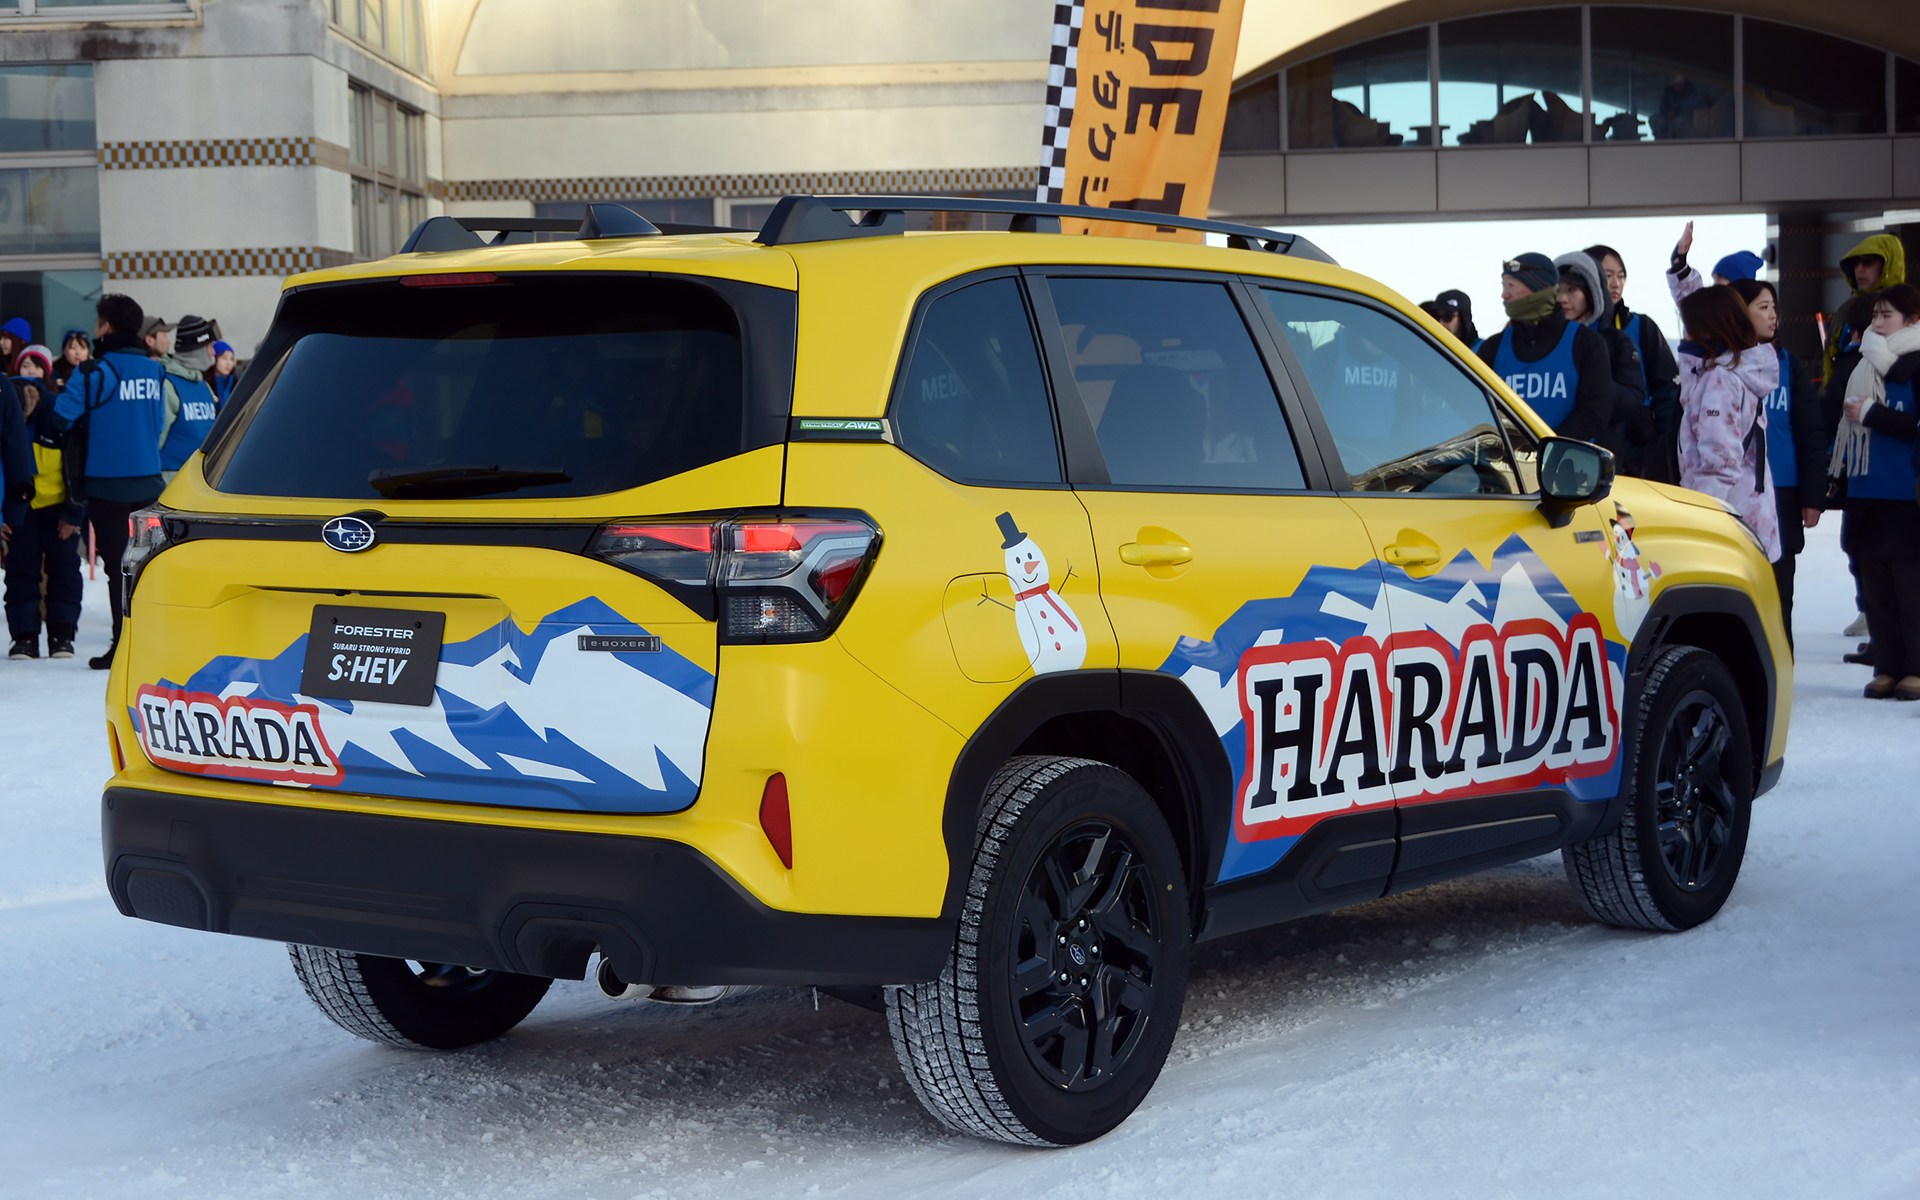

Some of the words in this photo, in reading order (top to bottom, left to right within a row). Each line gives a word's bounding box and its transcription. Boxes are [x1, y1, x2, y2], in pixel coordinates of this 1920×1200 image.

[1345, 366, 1398, 388] MEDIA
[844, 421, 880, 430] AWD
[214, 551, 510, 575] FORESTER
[334, 624, 415, 640] FORESTER
[332, 642, 358, 651] SUBARU
[358, 644, 385, 653] STRONG
[385, 646, 411, 655] HYBRID
[327, 654, 408, 685] S:HEV
[143, 703, 329, 768] HARADA
[1250, 641, 1607, 809] HARADA
